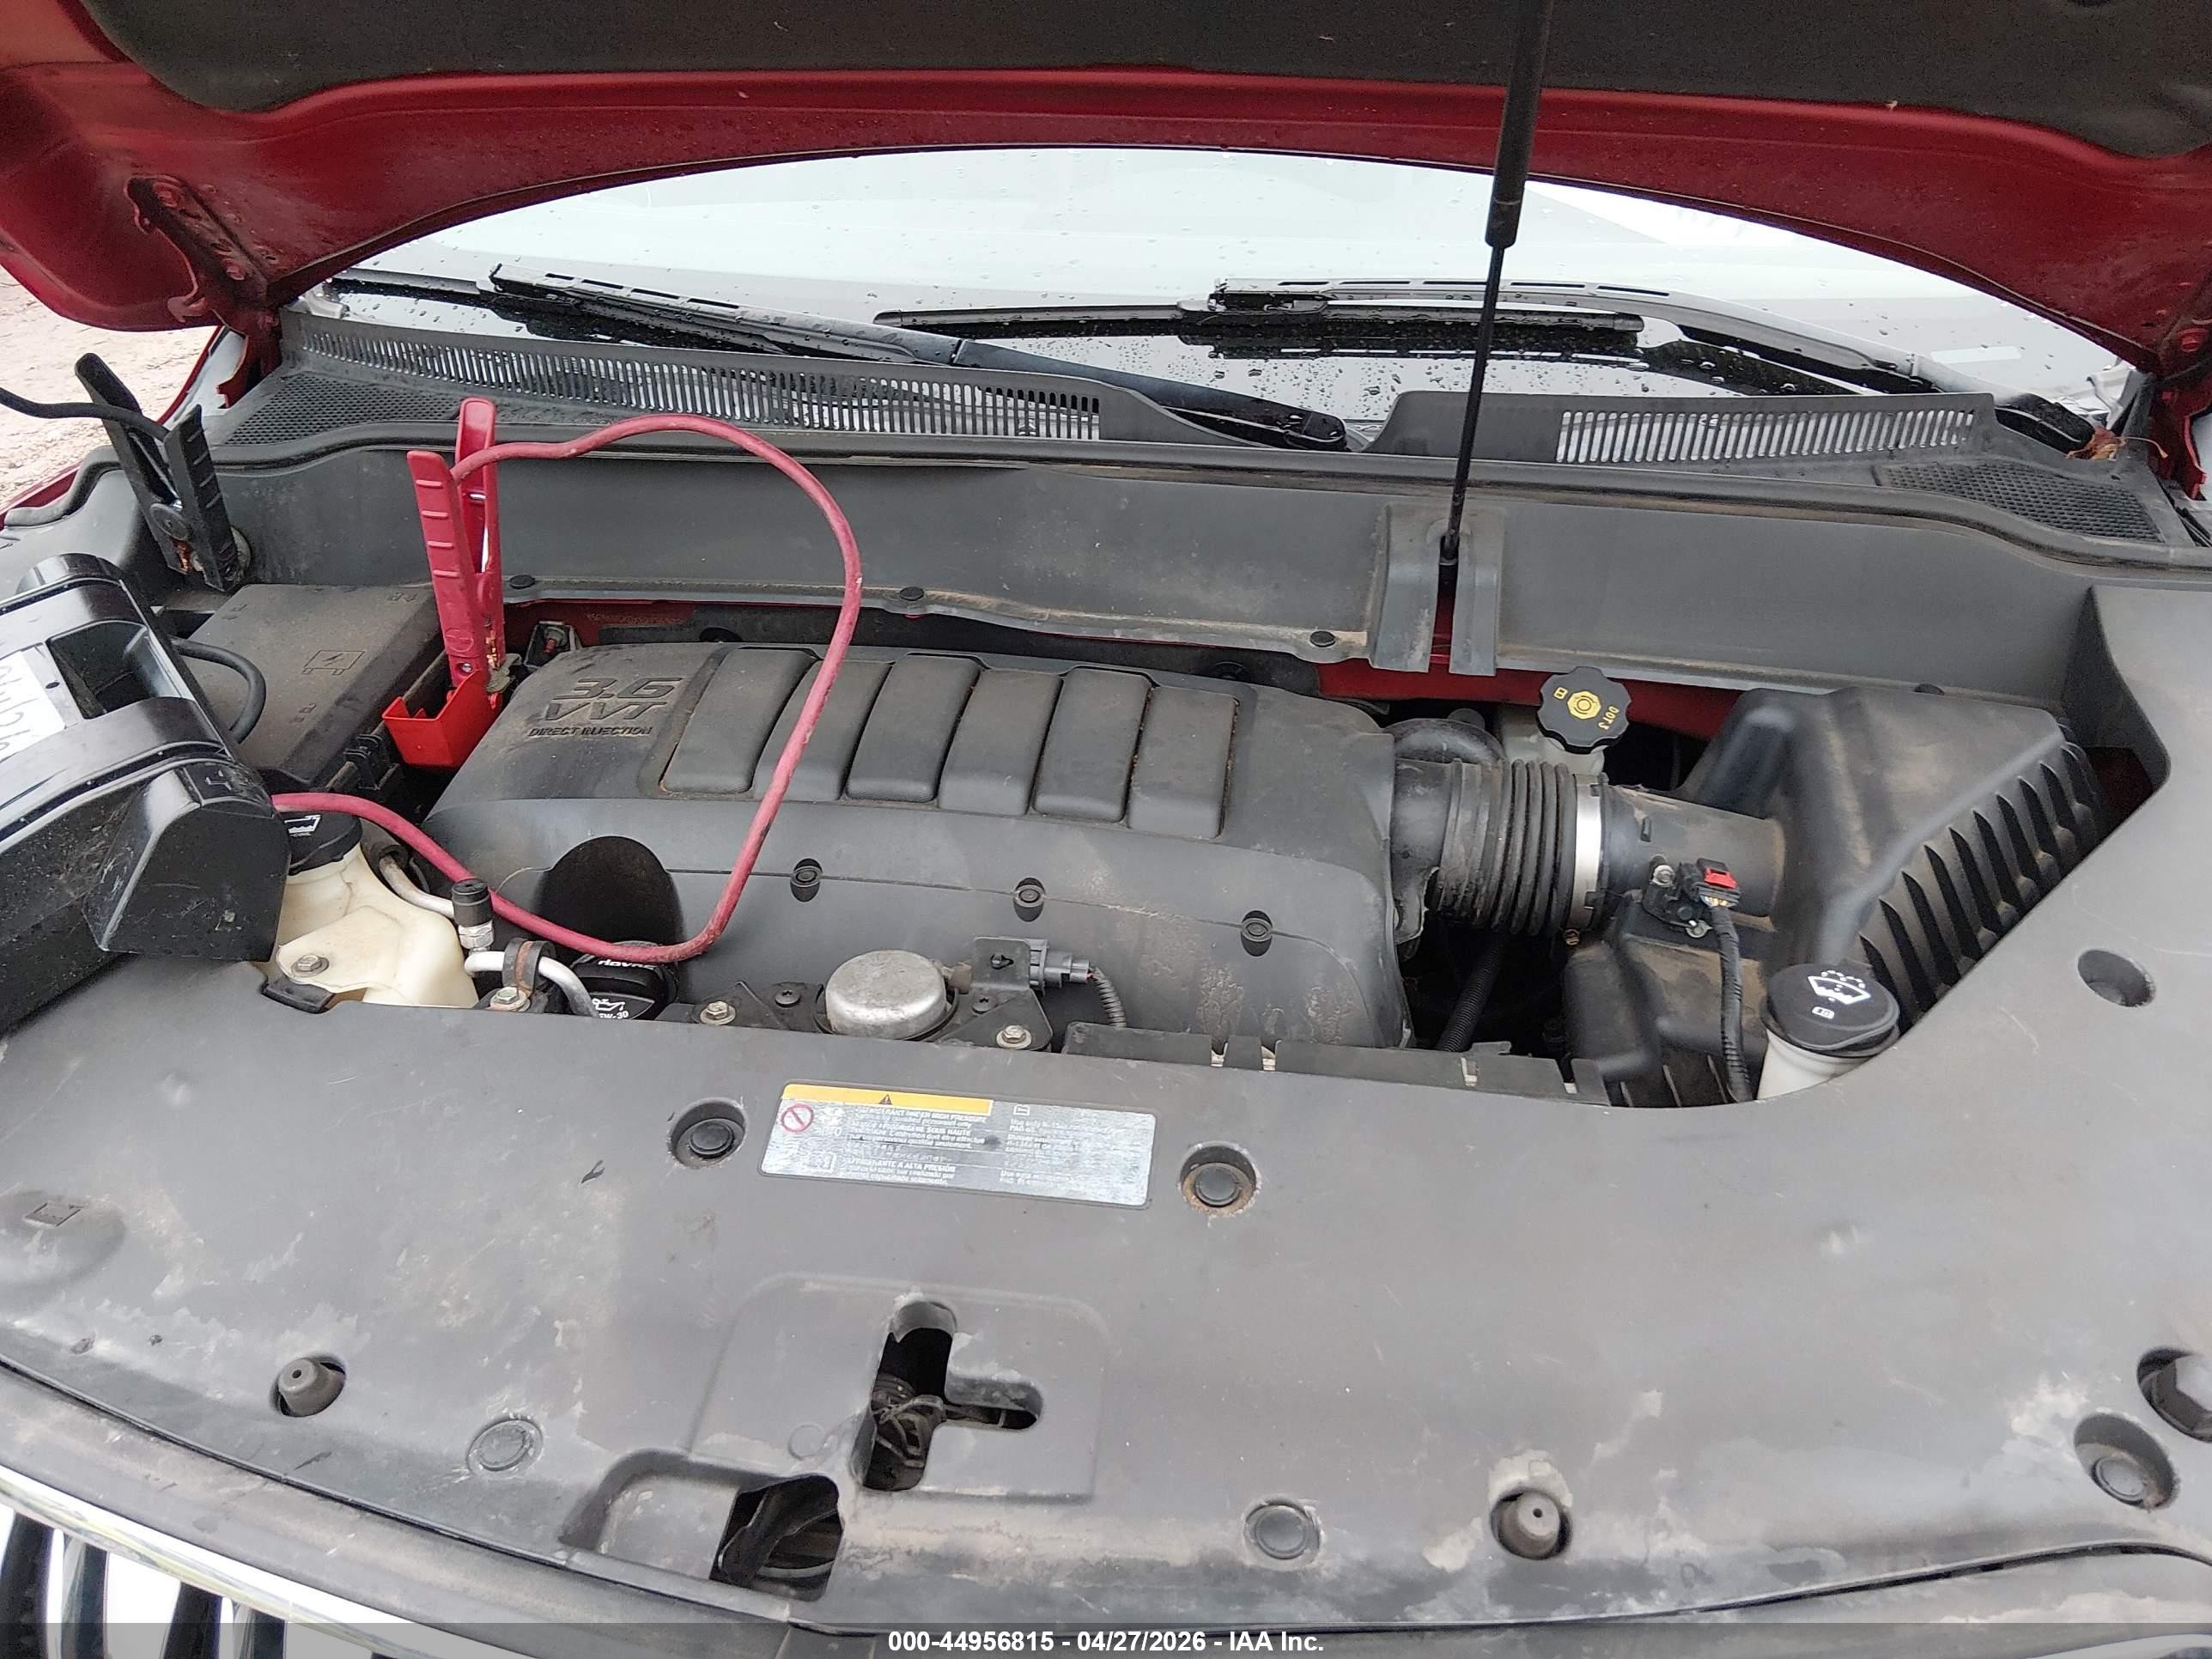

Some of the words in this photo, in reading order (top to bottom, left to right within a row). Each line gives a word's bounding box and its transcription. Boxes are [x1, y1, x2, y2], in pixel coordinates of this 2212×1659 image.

[553, 677, 684, 700] 3.6
[544, 700, 669, 721] VVT
[527, 726, 580, 738] DIRECT
[581, 726, 653, 737] INJECTION
